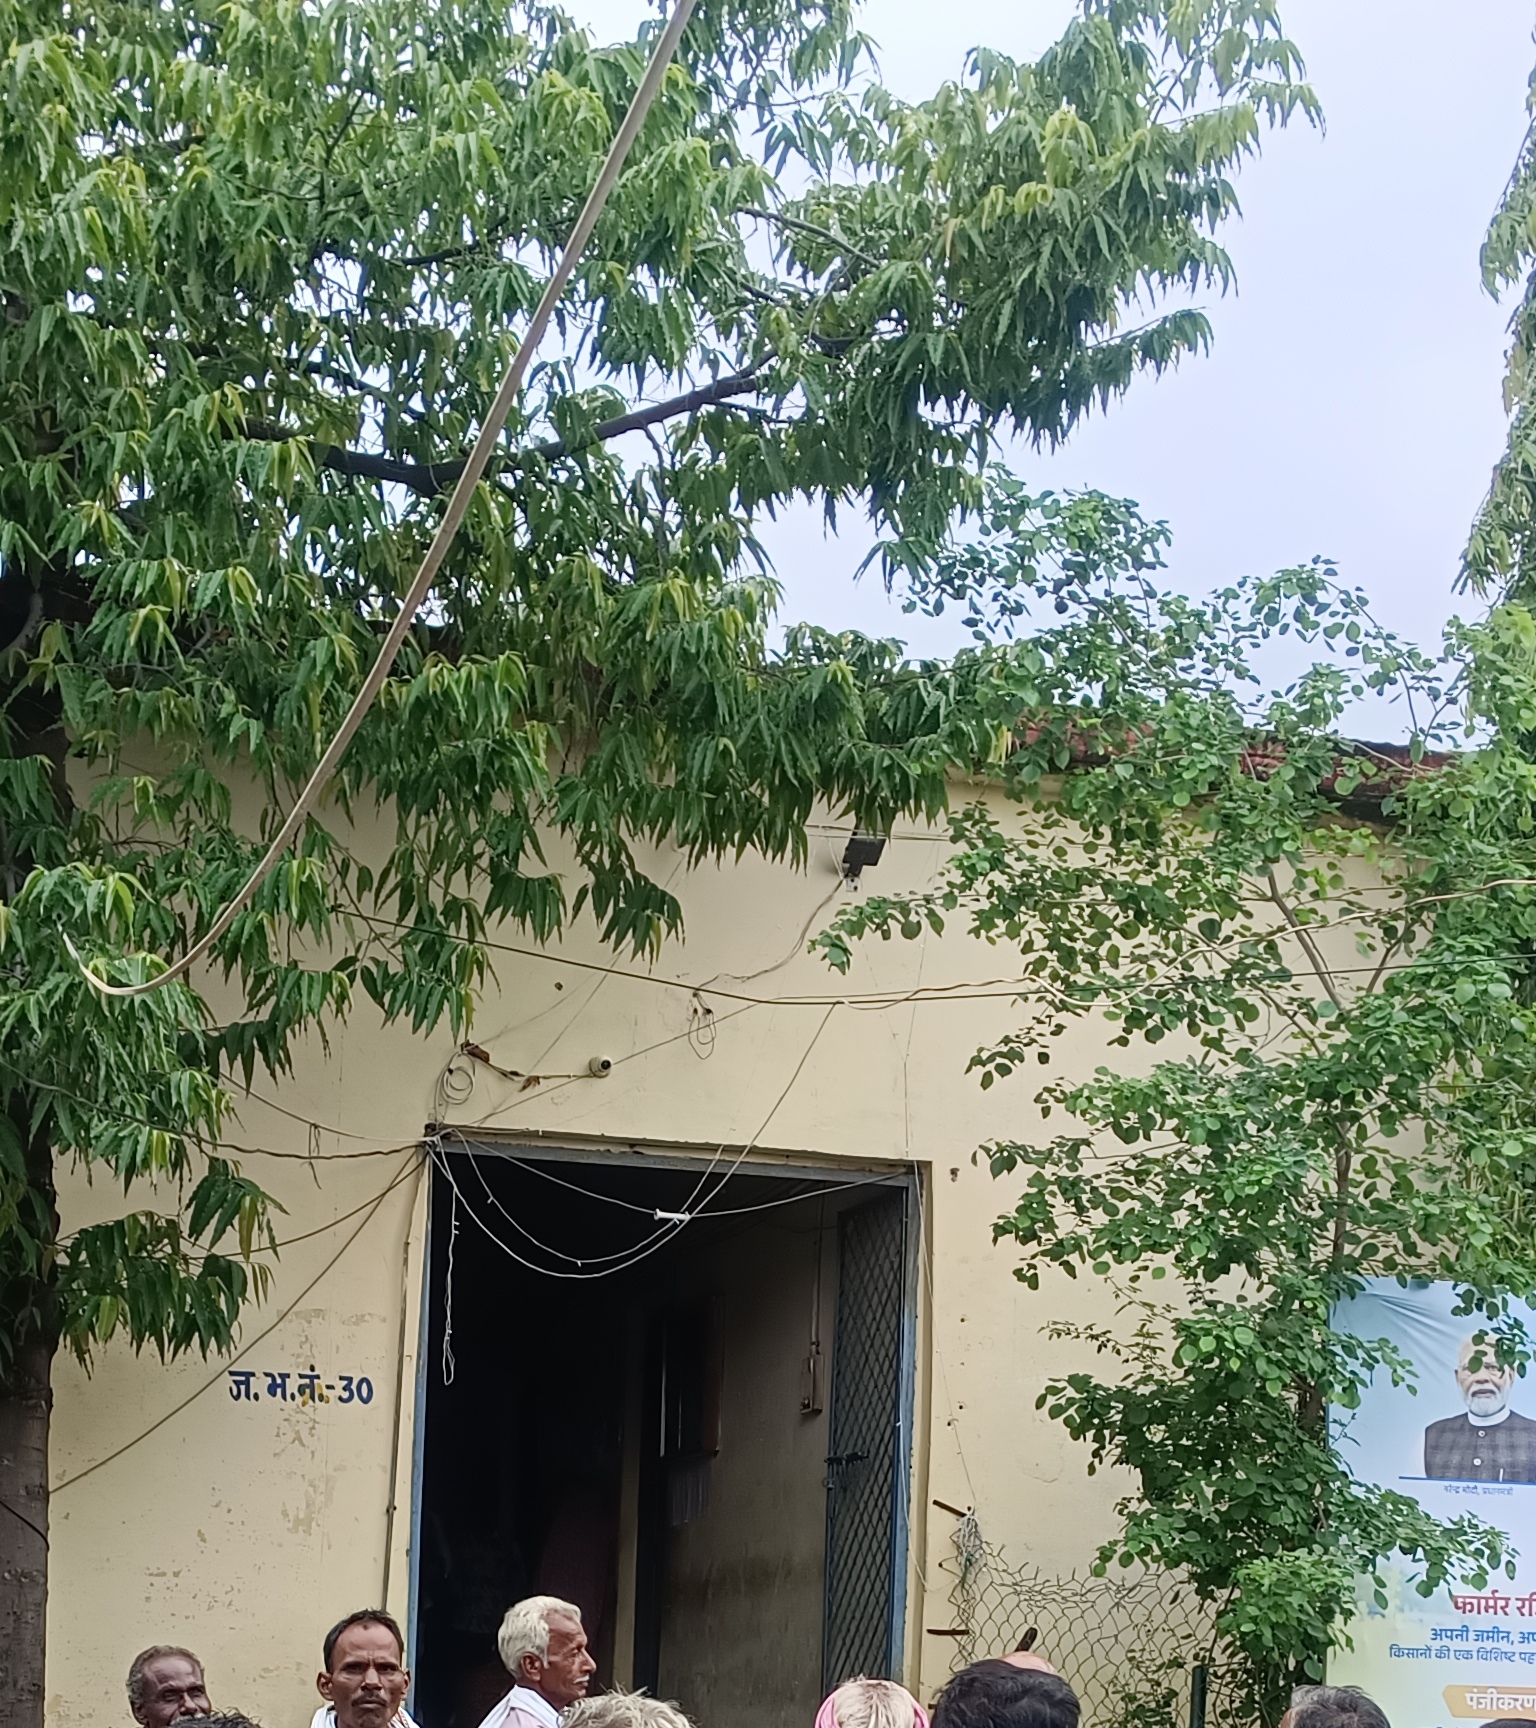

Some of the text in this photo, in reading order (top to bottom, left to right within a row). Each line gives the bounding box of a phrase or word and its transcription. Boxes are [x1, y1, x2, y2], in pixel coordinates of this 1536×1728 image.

[1453, 1590, 1511, 1616] फार्मर
[1431, 1625, 1472, 1642] अपनी
[1473, 1626, 1514, 1646] जमीन,
[1389, 1644, 1432, 1659] किसानों
[1435, 1644, 1450, 1660] की
[1454, 1650, 1473, 1661] एक
[1476, 1647, 1516, 1663] विशिष्ट
